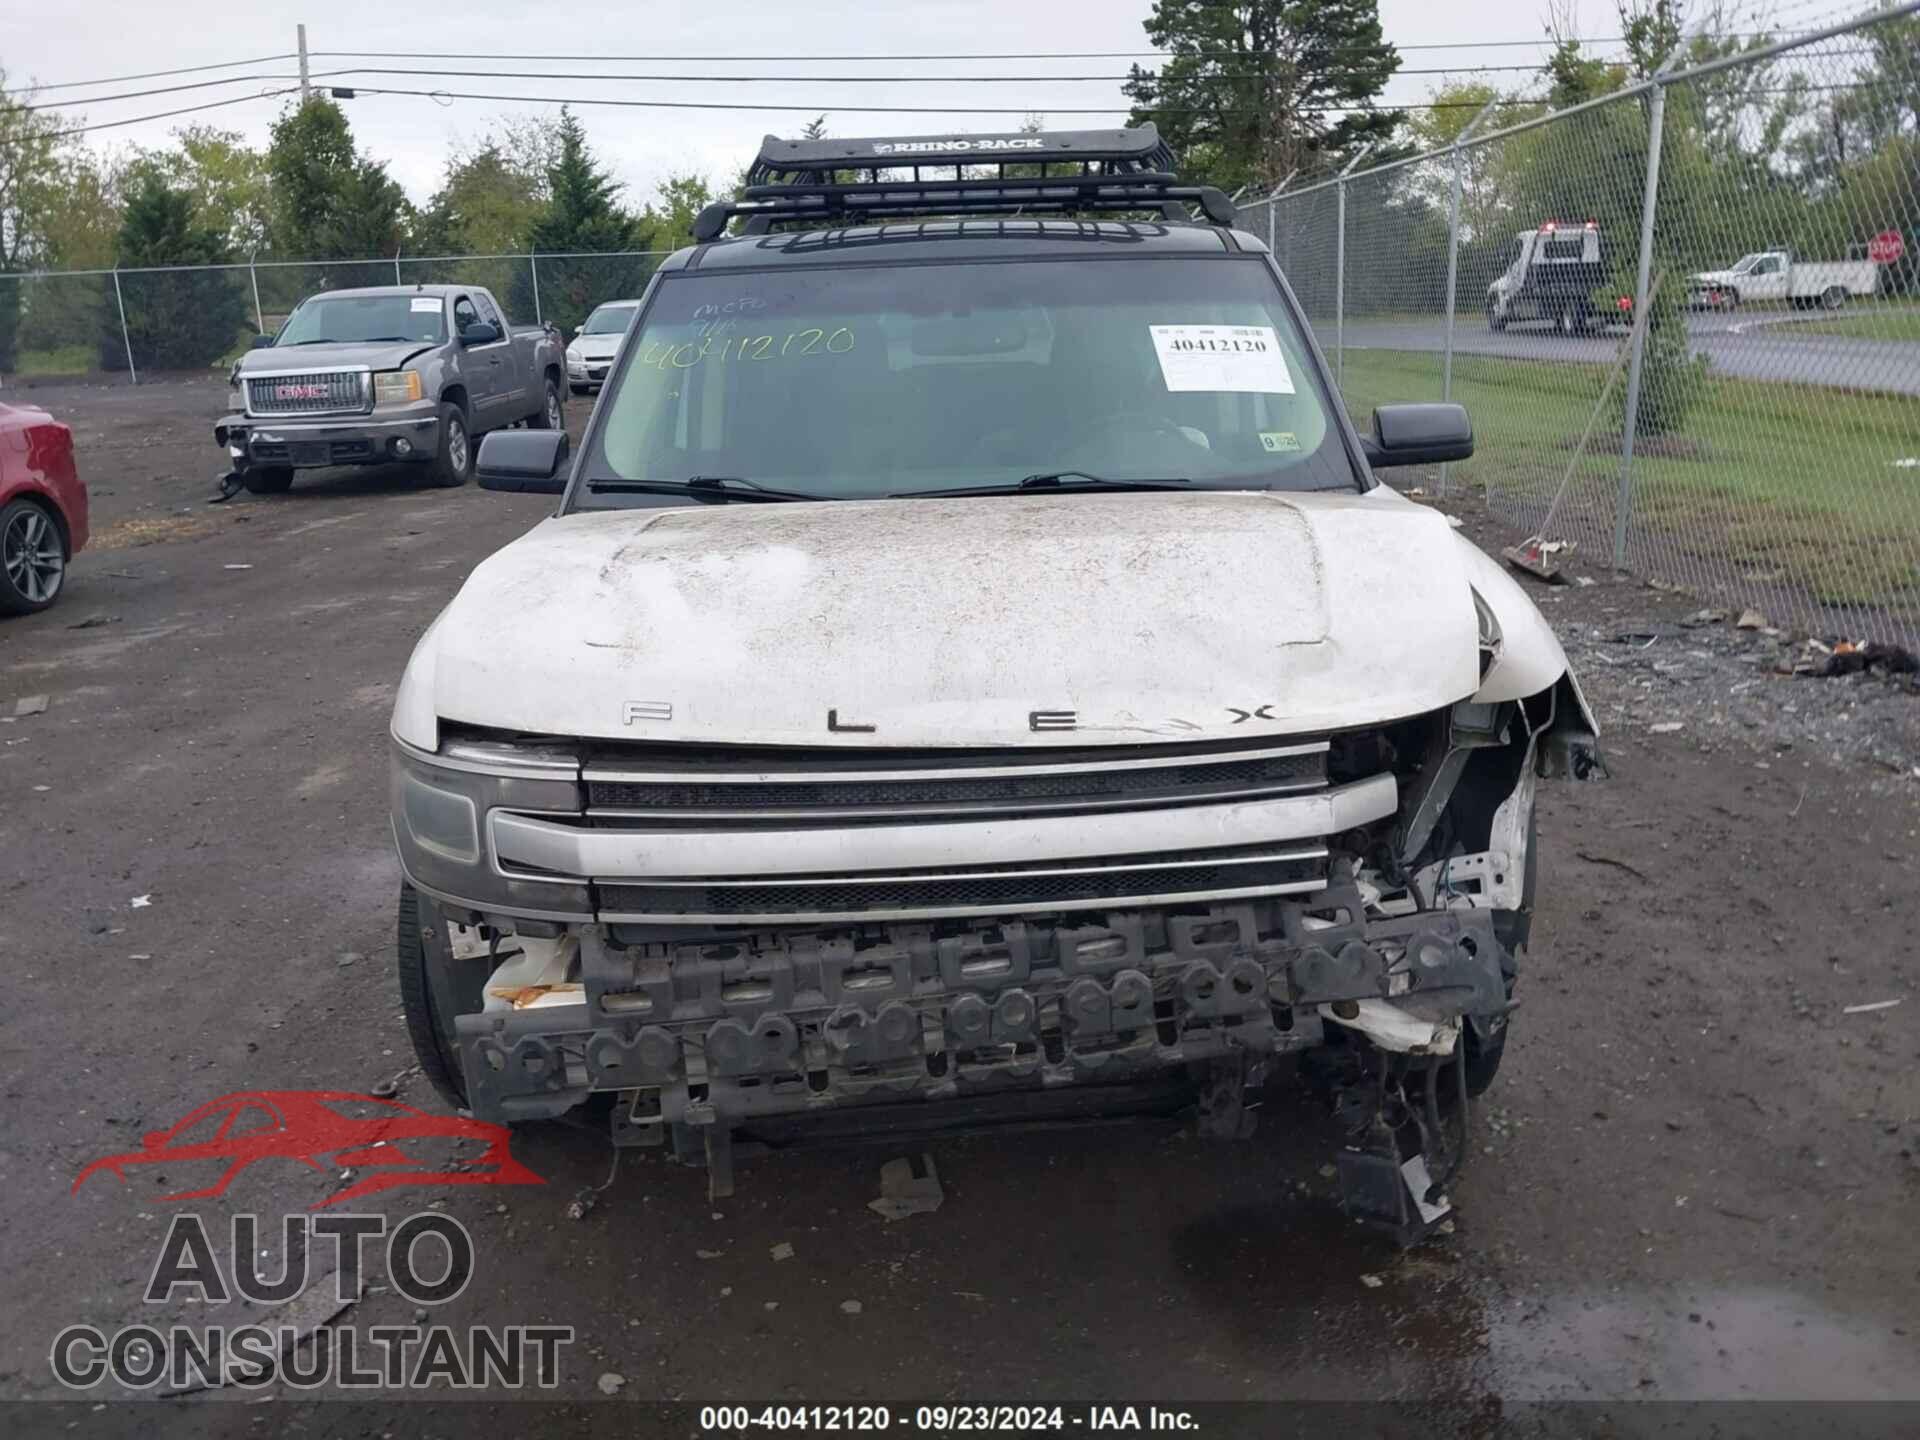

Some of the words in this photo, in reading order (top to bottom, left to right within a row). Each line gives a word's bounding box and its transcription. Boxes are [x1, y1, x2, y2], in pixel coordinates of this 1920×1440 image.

[893, 138, 1044, 153] RHINO-RACK
[1871, 240, 1902, 254] STOP
[643, 327, 856, 370] 40412120
[1170, 339, 1267, 352] 40412120
[276, 383, 329, 400] GMC
